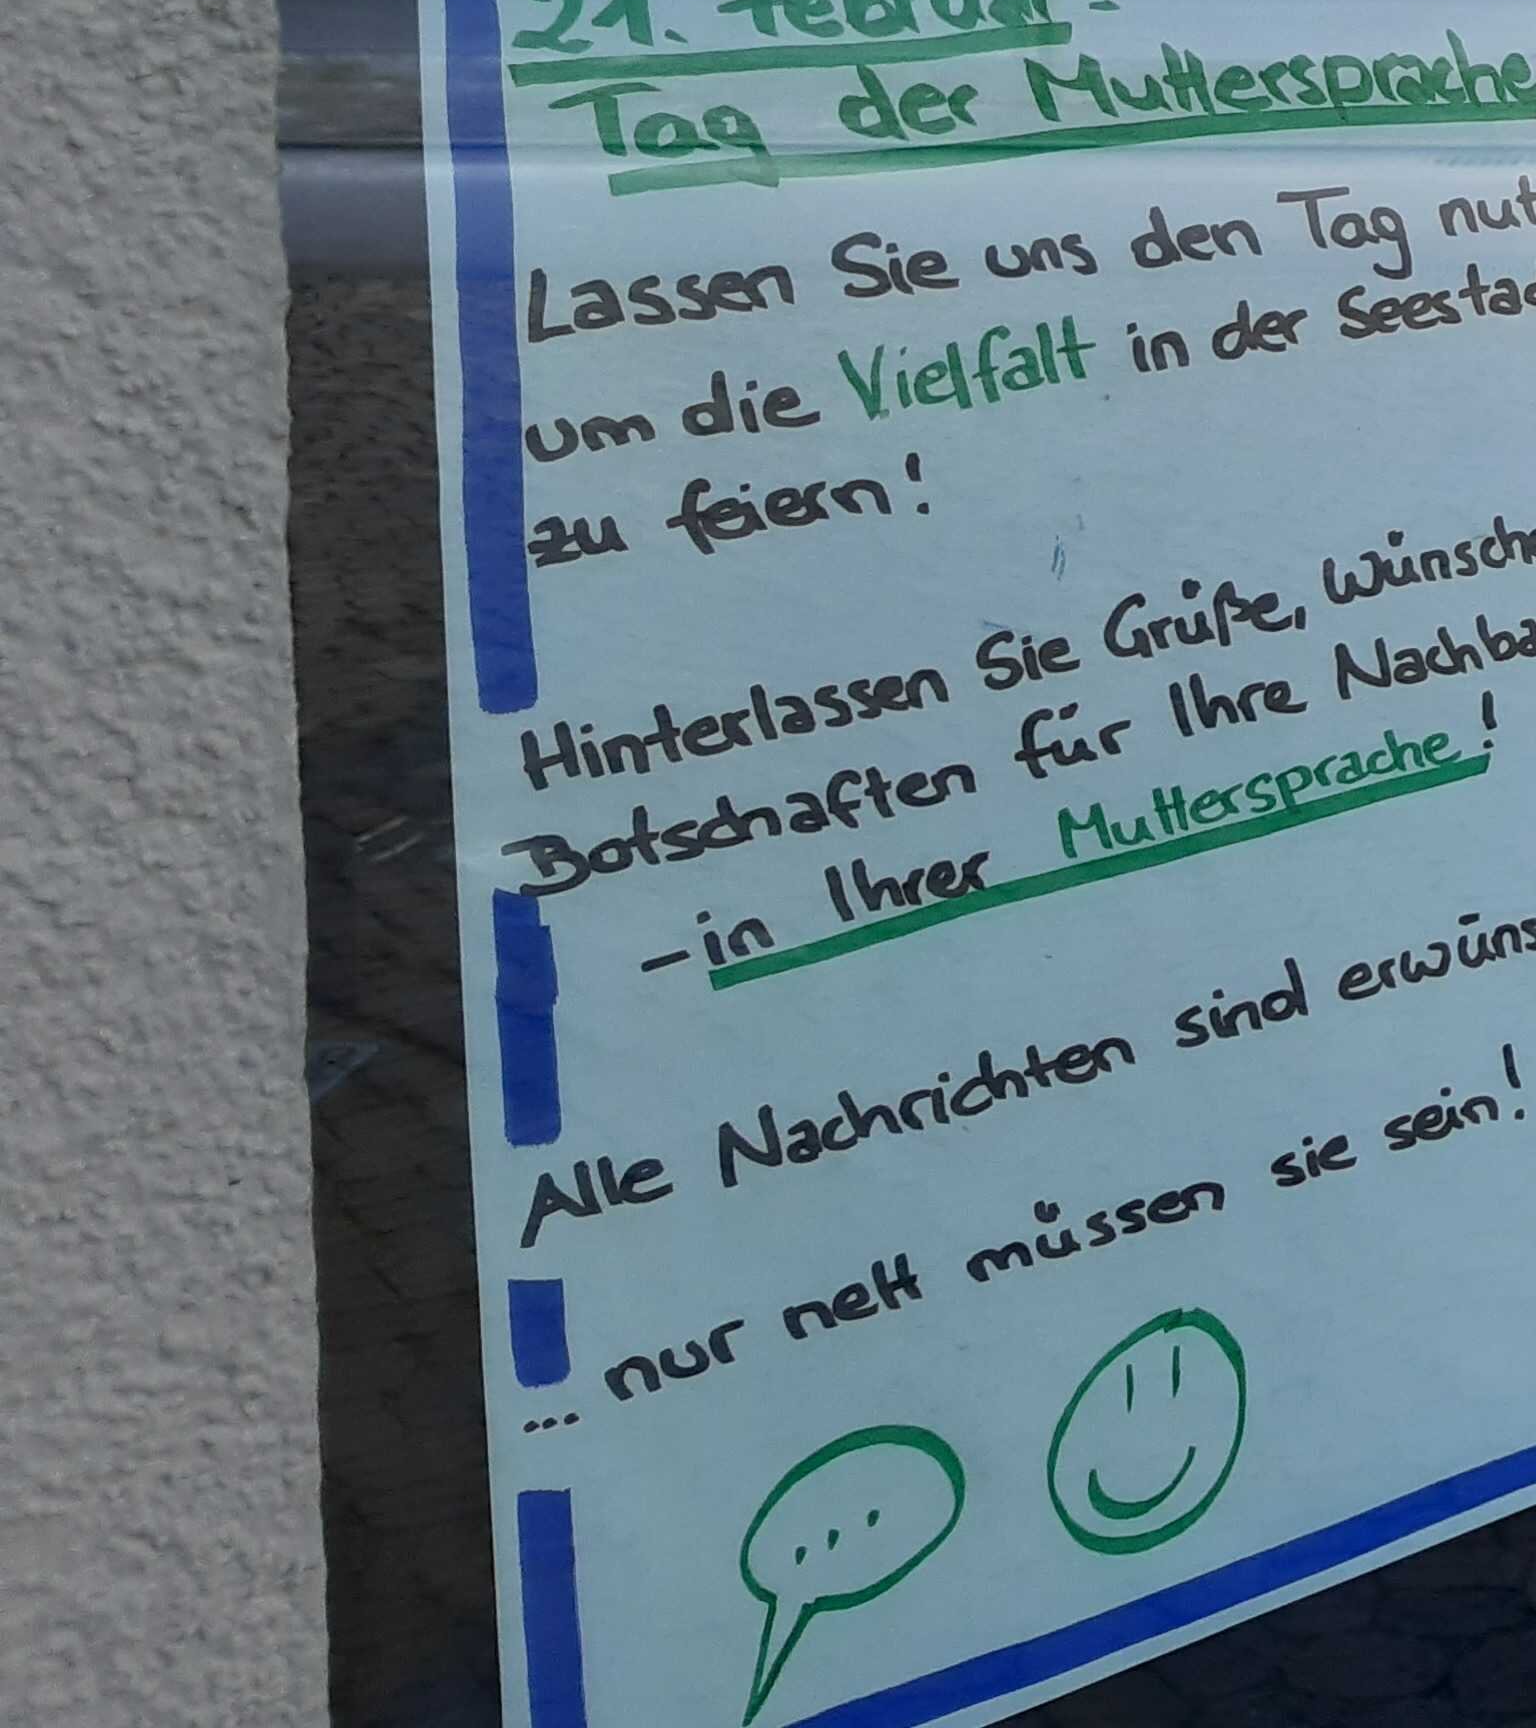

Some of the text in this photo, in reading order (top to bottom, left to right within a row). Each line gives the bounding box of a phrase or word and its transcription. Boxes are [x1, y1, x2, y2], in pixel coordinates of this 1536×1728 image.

[548, 83, 780, 189] Tag
[838, 65, 979, 141] der
[528, 266, 795, 343] Lassen
[831, 232, 959, 298] Sie
[984, 233, 1098, 279] uns
[1131, 206, 1263, 270] den
[1276, 186, 1412, 280] Tag
[525, 412, 656, 463] um
[682, 370, 821, 436] die
[837, 314, 1096, 421] Vielfalt
[1126, 321, 1190, 373] in
[1211, 300, 1309, 361] der
[528, 450, 930, 568] zu feiern!
[501, 762, 977, 897] Botschaften
[1015, 701, 1132, 779] für
[1168, 673, 1308, 736] Ihre
[520, 668, 949, 790] Hinterlassen
[975, 629, 1081, 690] Sie
[1103, 578, 1306, 659] Grüße,
[823, 849, 991, 922] Ihrer
[1056, 689, 1498, 859] Muttersprache!
[519, 1155, 675, 1249] Alle
[717, 1035, 1137, 1188] Nachrichten
[1174, 956, 1309, 1048] sind
[604, 1317, 745, 1402] nur
[782, 1251, 924, 1340] nett
[965, 1180, 1226, 1283] müssen
[1270, 1134, 1358, 1188] sie
[1383, 1042, 1526, 1152] sein!
